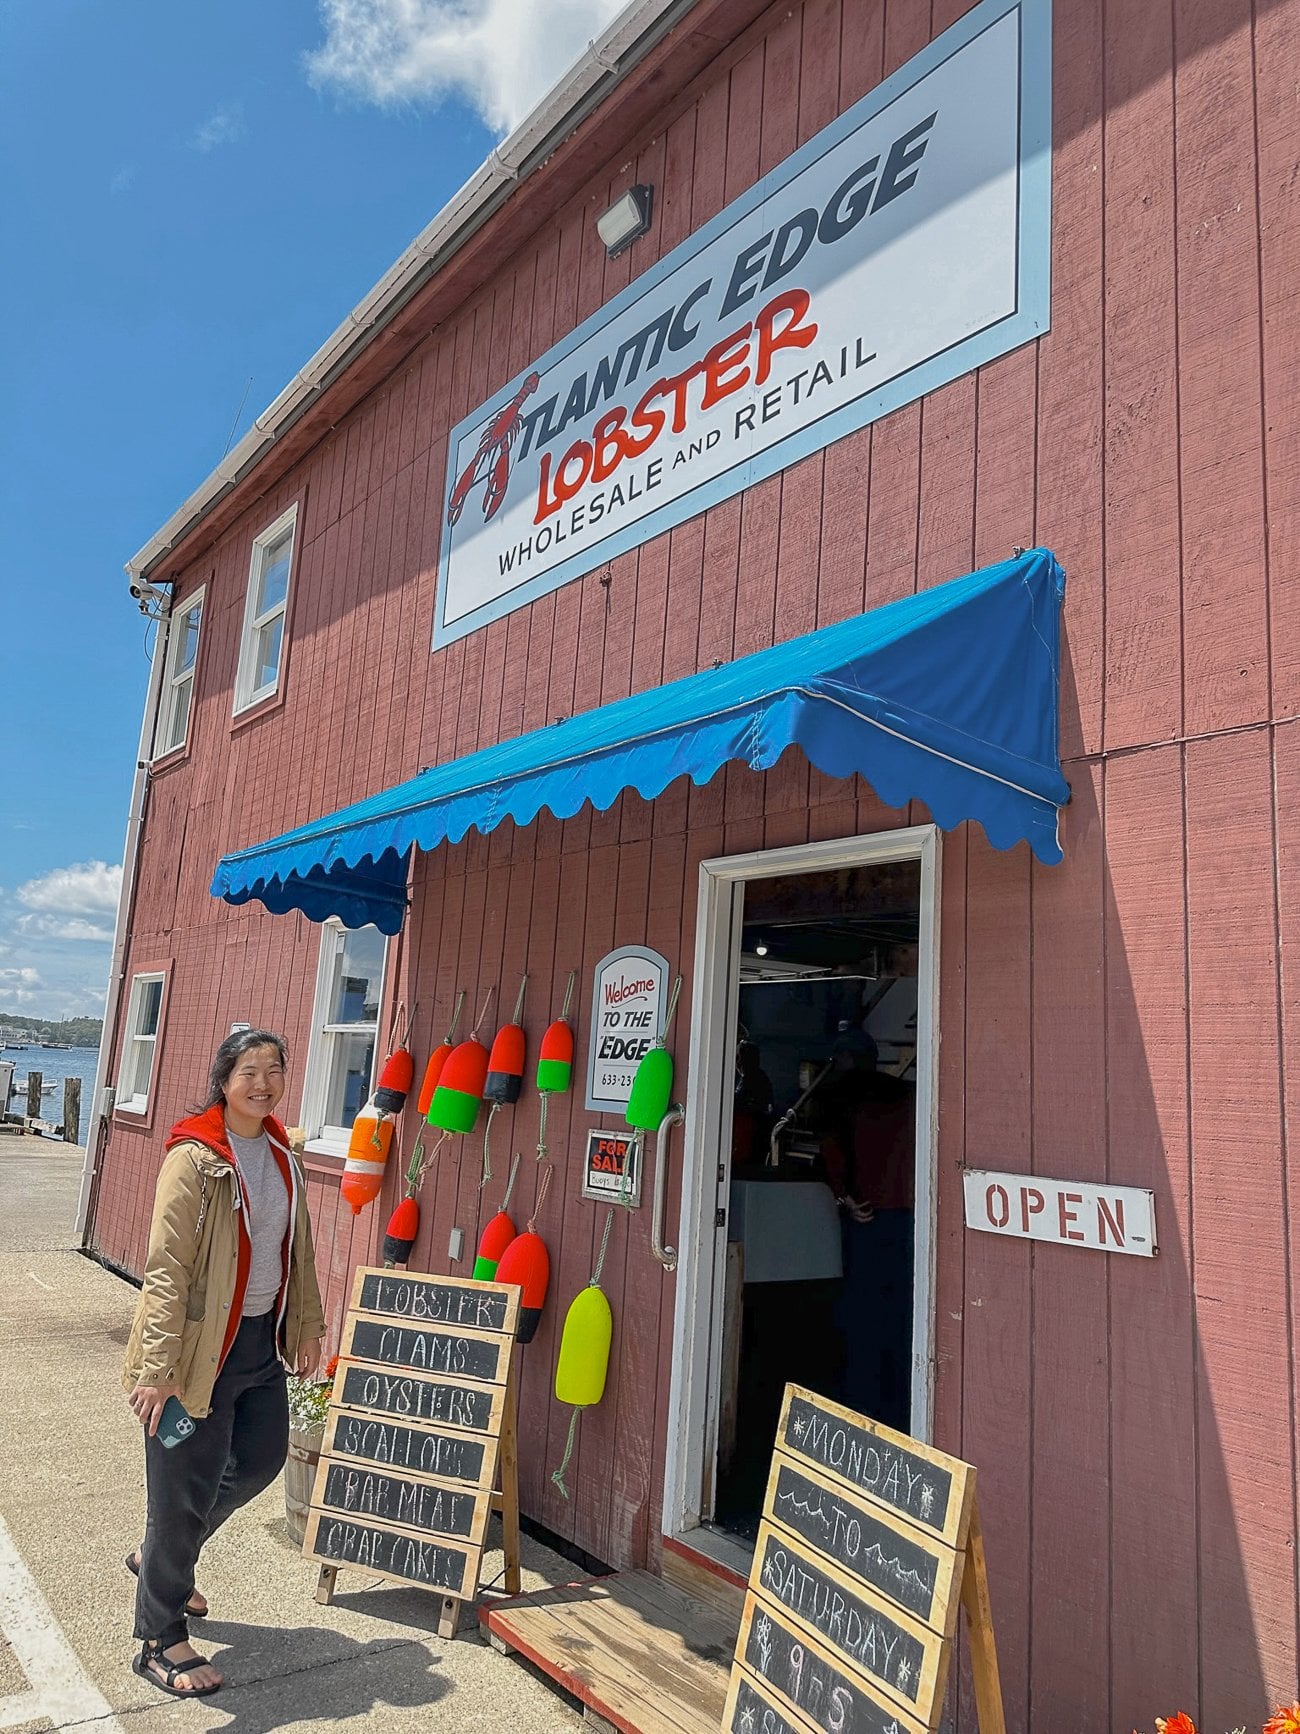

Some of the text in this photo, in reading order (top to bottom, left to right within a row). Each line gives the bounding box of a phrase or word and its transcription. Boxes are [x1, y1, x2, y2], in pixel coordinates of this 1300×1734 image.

[718, 111, 938, 321] EDGE
[533, 288, 819, 526] LOBSTER
[499, 337, 877, 576] WHOLESALE AND RETAIL
[605, 975, 656, 1006] Welcome
[603, 1011, 652, 1028] TO THE
[601, 1073, 636, 1087] 633-23
[592, 1154, 625, 1174] SAL
[598, 1140, 627, 1156] FOR
[985, 1183, 1126, 1248] OPEN
[375, 1278, 494, 1327] LOBSTER
[378, 1327, 470, 1374] CLAMS
[363, 1375, 476, 1426] OYSTERS
[803, 1414, 923, 1505] MONDAY
[830, 1505, 862, 1557] TO
[769, 1550, 899, 1681] SATURDAY
